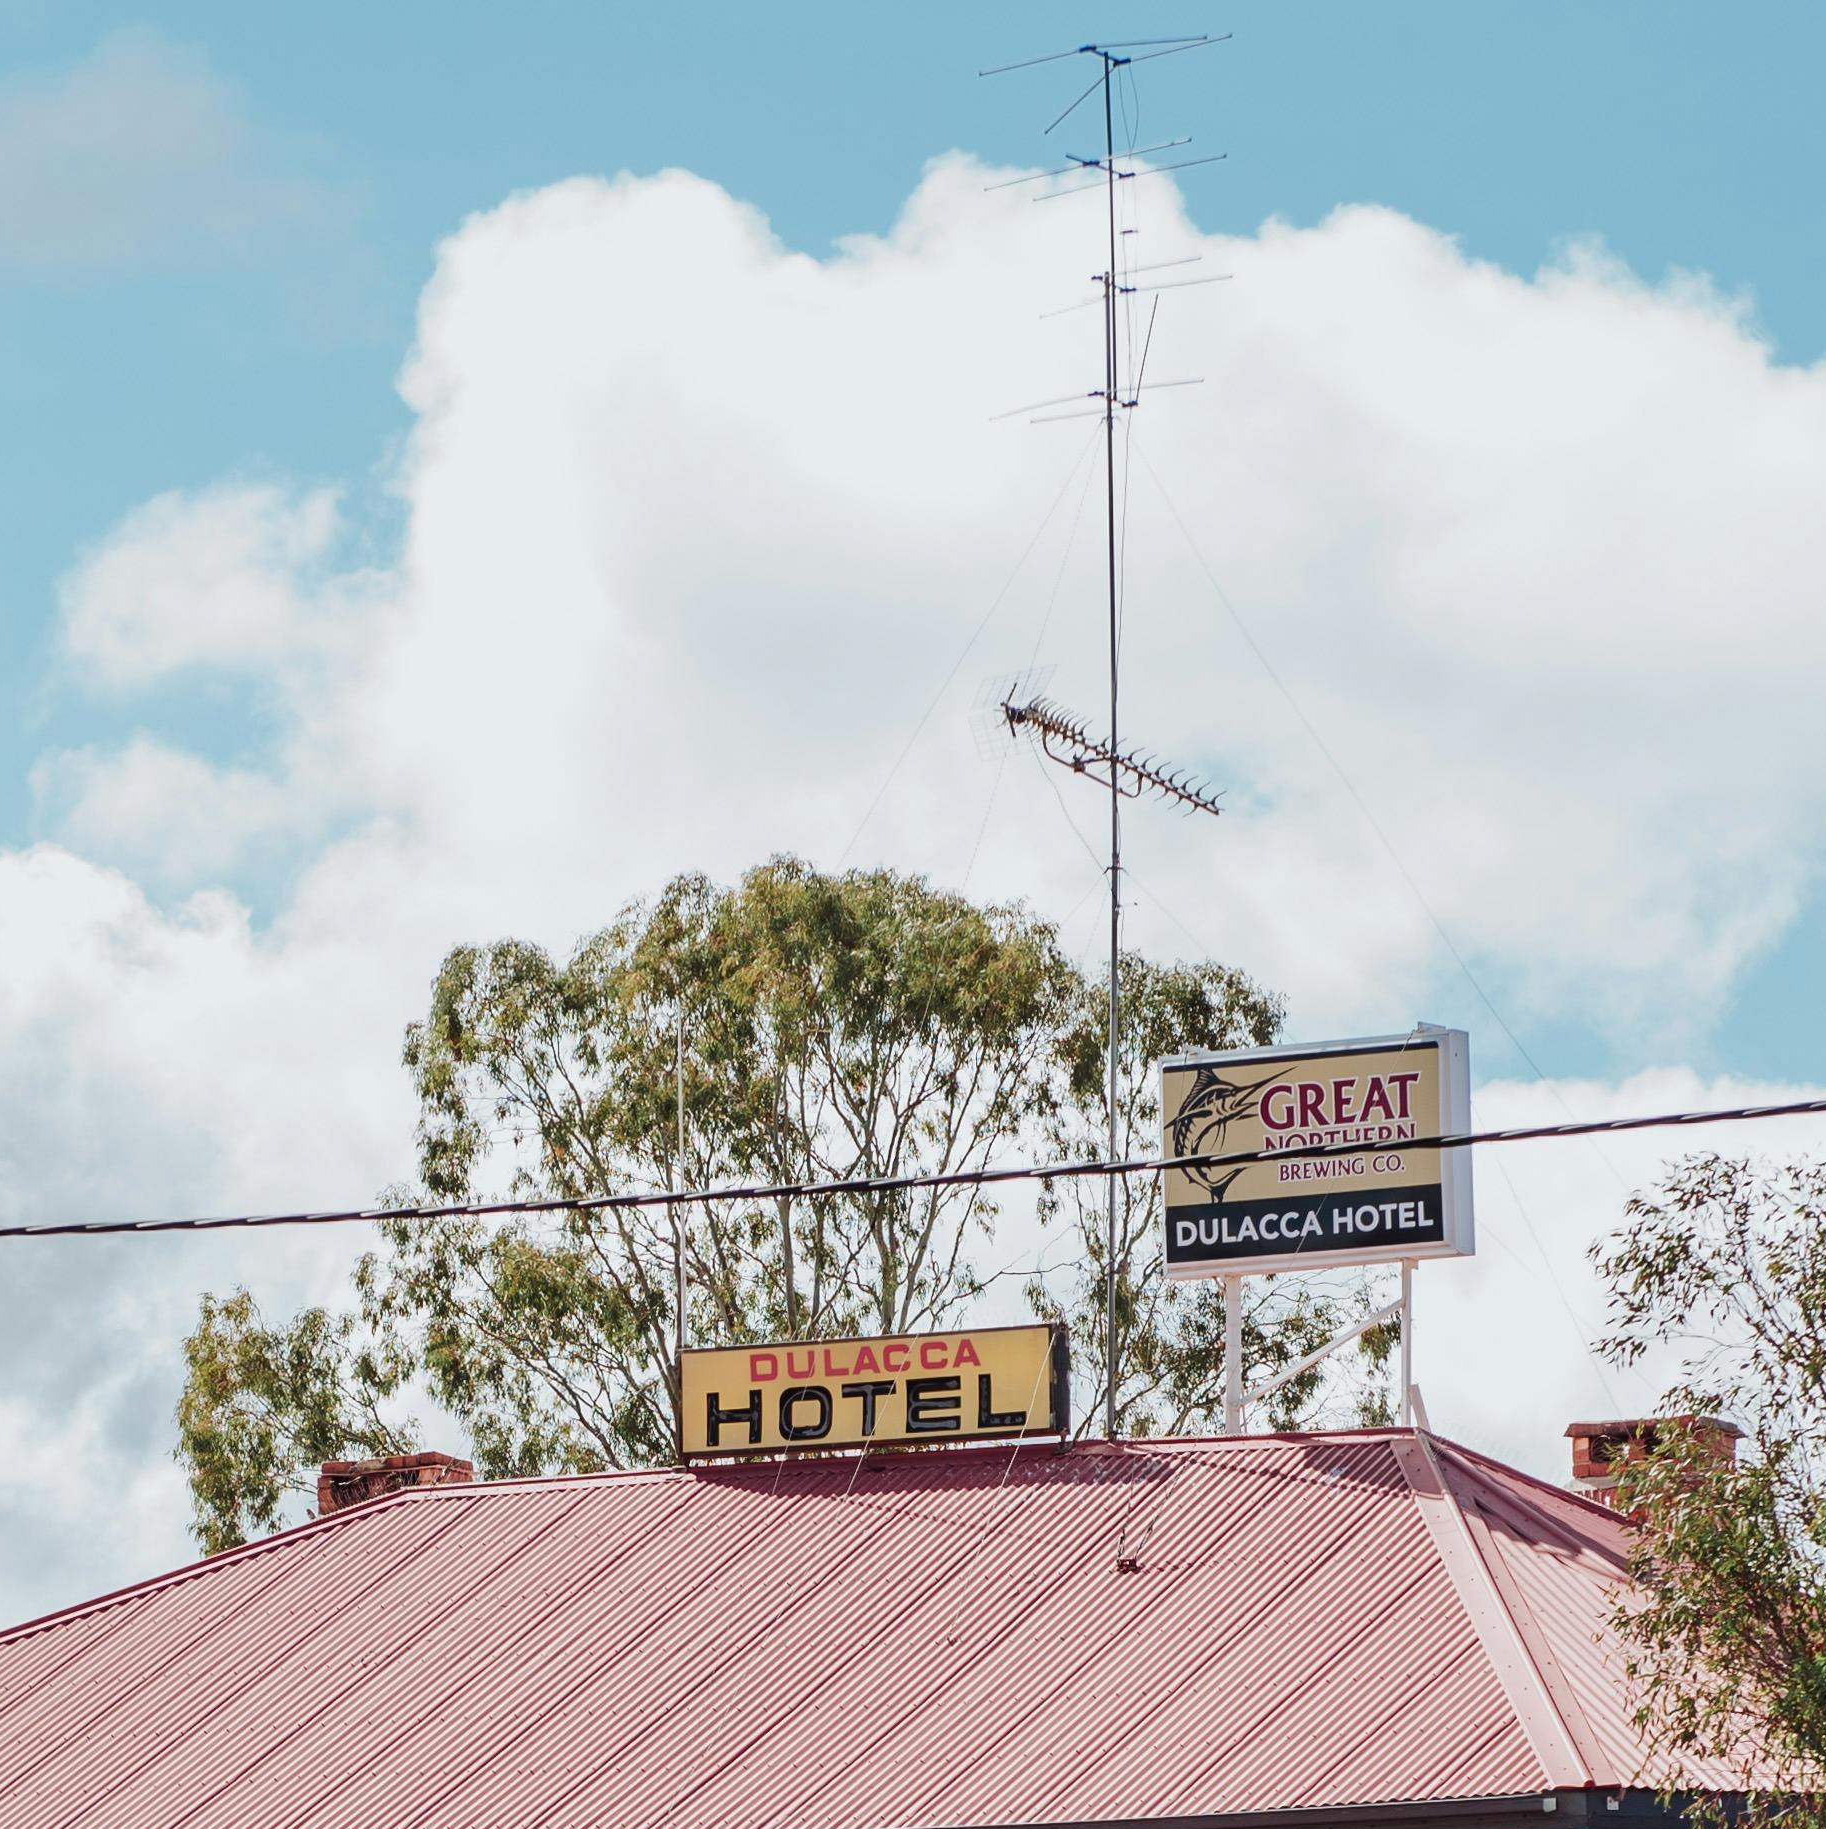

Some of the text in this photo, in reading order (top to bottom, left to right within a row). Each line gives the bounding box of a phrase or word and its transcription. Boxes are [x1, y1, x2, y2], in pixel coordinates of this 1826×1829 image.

[1259, 1072, 1421, 1131] GREAT
[1279, 1154, 1406, 1183] BREWING CO.
[1176, 1201, 1434, 1247] DULACCA HOTEL
[749, 1339, 981, 1382] DULACCA
[706, 1374, 1027, 1447] HOTEL
